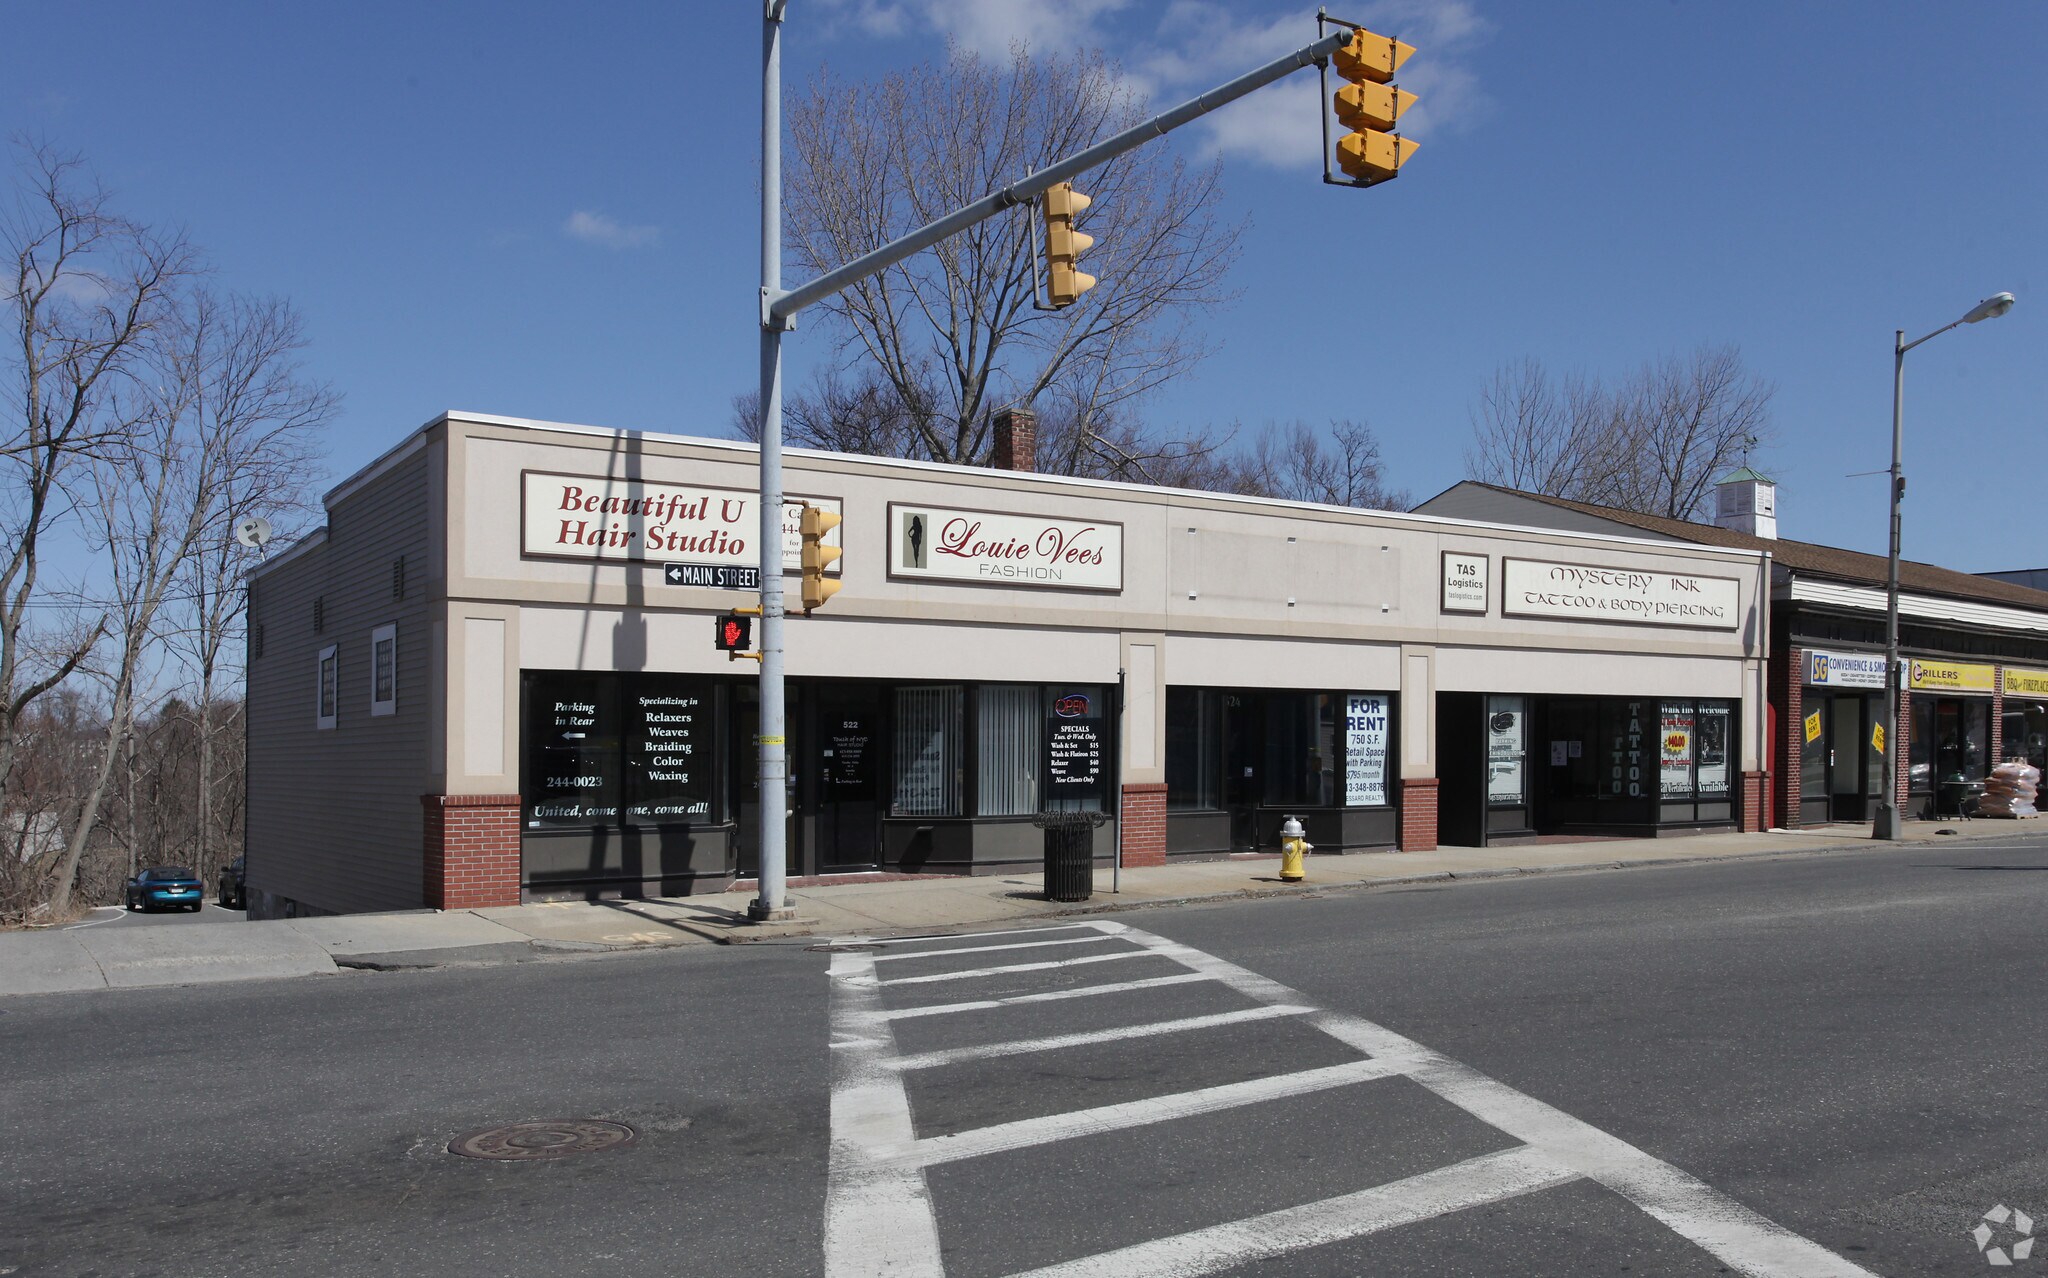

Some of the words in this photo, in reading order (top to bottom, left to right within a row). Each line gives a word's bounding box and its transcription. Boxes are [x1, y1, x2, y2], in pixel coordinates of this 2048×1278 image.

[557, 485, 710, 526] Beautiful
[720, 498, 747, 523] U
[555, 519, 637, 549] Hair
[645, 525, 746, 556] Studio
[935, 517, 1030, 560] Louie
[1035, 527, 1104, 565] Vees
[979, 563, 1062, 580] FASHION
[1456, 563, 1476, 576] TAS
[683, 566, 713, 585] MAIN
[717, 568, 758, 588] STREET
[1448, 577, 1484, 589] Logistics
[1550, 567, 1653, 594] MYSTERY
[1671, 578, 1701, 593] INK
[1524, 591, 1596, 607] TATTOO
[1598, 598, 1607, 610] &
[1611, 598, 1653, 617] BODY
[1655, 604, 1724, 619] PIERCING
[1814, 657, 1828, 681] SG
[1829, 658, 1867, 672] CONVENIENCE
[1869, 661, 1873, 672] &
[1874, 661, 1886, 672] SMO
[1913, 662, 1958, 681] GRILLERS
[2007, 677, 2018, 691] BBQ
[554, 702, 596, 714] Parking
[639, 697, 688, 707] Specializing
[689, 697, 698, 705] in
[1055, 699, 1088, 714] OPEN
[1351, 699, 1380, 714] FOR
[555, 716, 566, 726] in
[569, 716, 595, 726] Rear
[645, 712, 692, 723] Relaxers
[1346, 717, 1385, 731] RENT
[843, 721, 858, 729] 522
[648, 727, 689, 737] Weaves
[1085, 733, 1097, 741] Only
[1351, 734, 1365, 744] 750
[1367, 734, 1380, 744] S.F.
[644, 741, 692, 754] Braiding
[1346, 747, 1364, 757] Retail
[1366, 748, 1384, 759] Space
[1628, 702, 1640, 797] TATTOO
[653, 756, 684, 767] Color
[1346, 758, 1359, 767] with
[1360, 759, 1382, 768] Parking
[546, 776, 603, 787] 244-0023
[648, 771, 688, 784] Waxing
[1698, 781, 1729, 793] Available
[534, 804, 582, 818] United,
[586, 806, 617, 816] come
[626, 806, 651, 817] one,
[654, 805, 684, 815] come
[687, 802, 709, 814] all!
